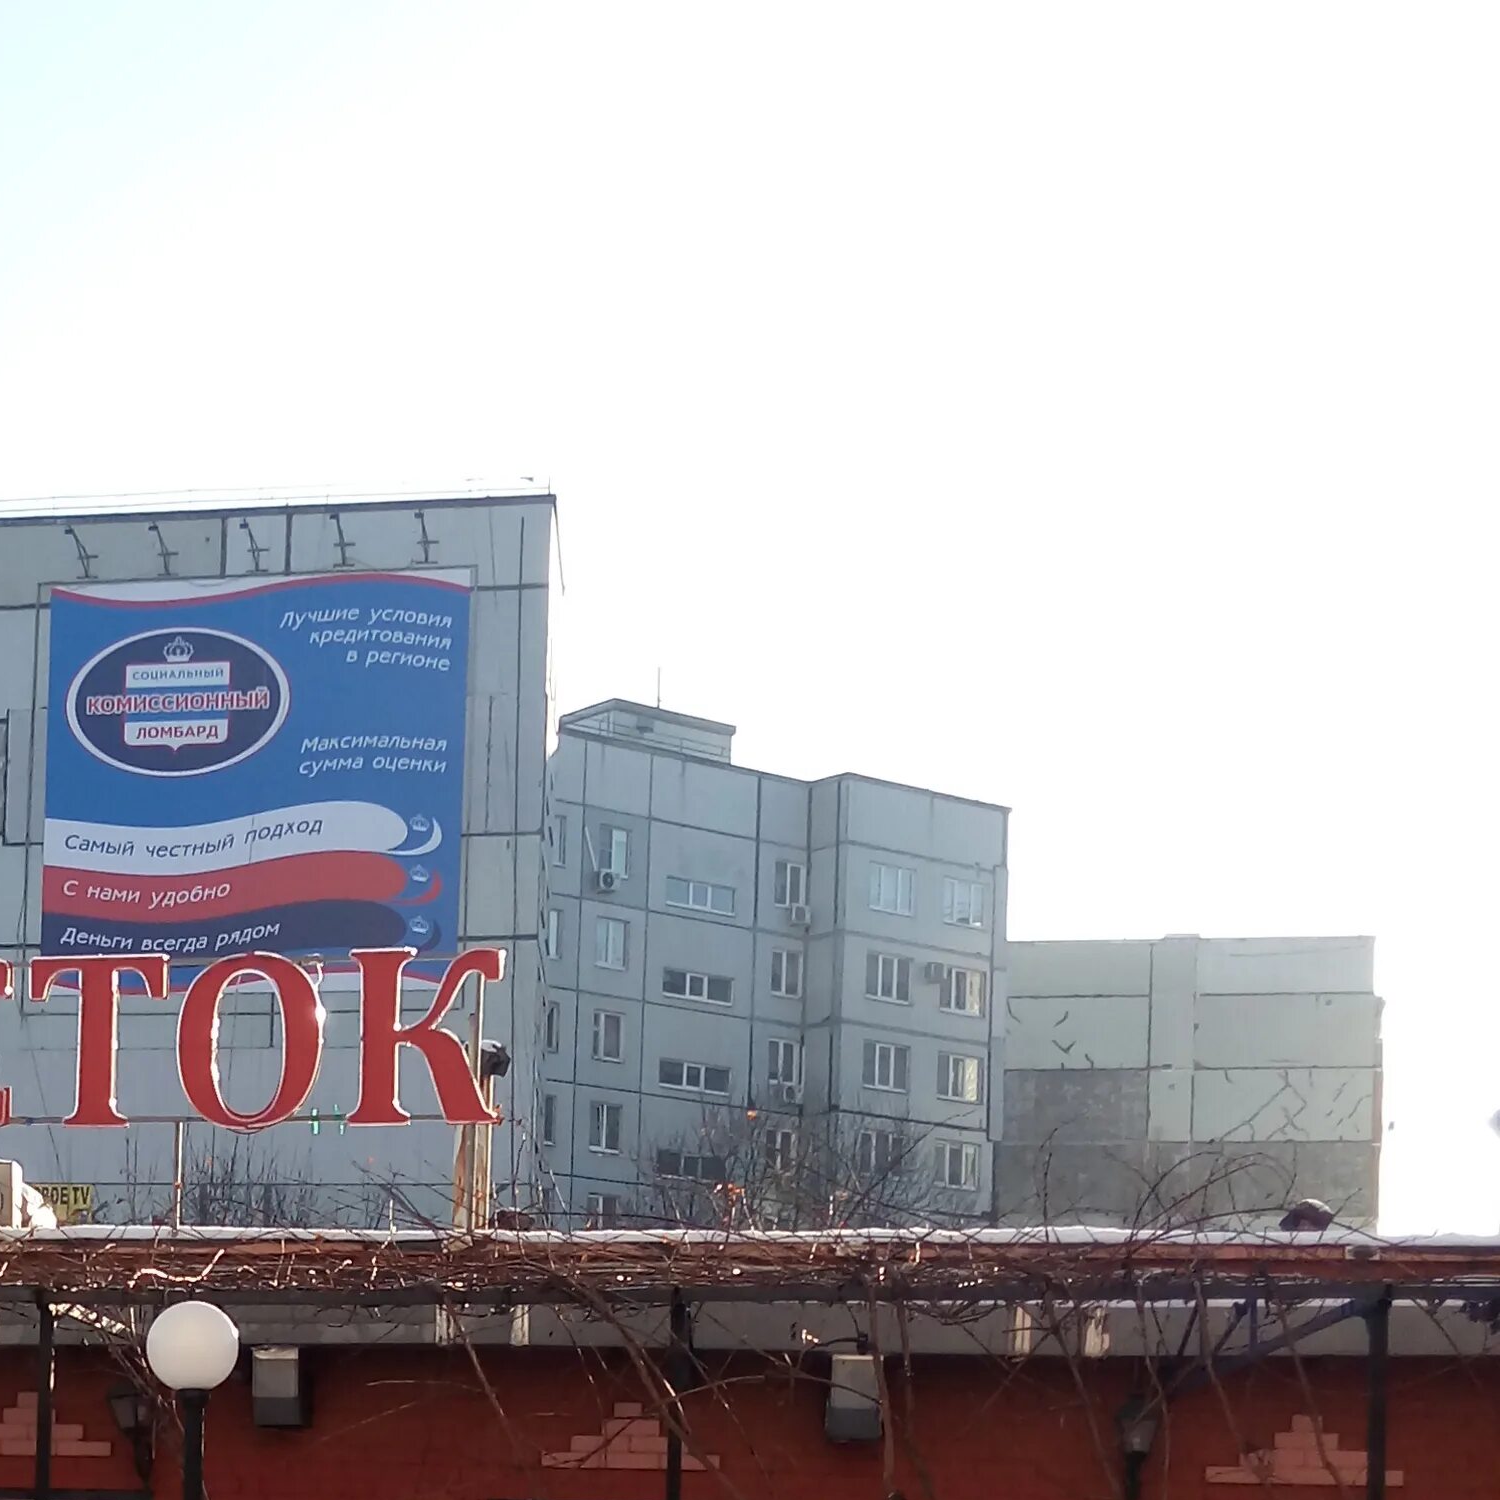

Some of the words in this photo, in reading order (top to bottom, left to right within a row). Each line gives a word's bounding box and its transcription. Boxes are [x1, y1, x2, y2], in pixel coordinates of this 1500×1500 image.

[280, 608, 360, 631] Лучшие
[368, 607, 453, 629] условия
[309, 628, 452, 650] кредитования
[346, 650, 358, 663] в
[365, 650, 451, 672] регионе
[132, 668, 224, 682] СОЦИАЛЬНЫЙ
[86, 686, 270, 716] КОМИССИОННЫЙ
[136, 725, 219, 740] ЛОМБАРД
[301, 735, 447, 753] Максимальная
[299, 756, 363, 778] сумма
[372, 756, 447, 773] оценки
[64, 834, 134, 857] Самый
[146, 834, 234, 858] честный
[244, 818, 323, 845] подход
[63, 880, 79, 896] С
[87, 884, 140, 904] нами
[148, 882, 231, 910] удобно
[60, 926, 133, 950] Деньги
[141, 934, 208, 953] всегда
[215, 922, 281, 951] рядом
